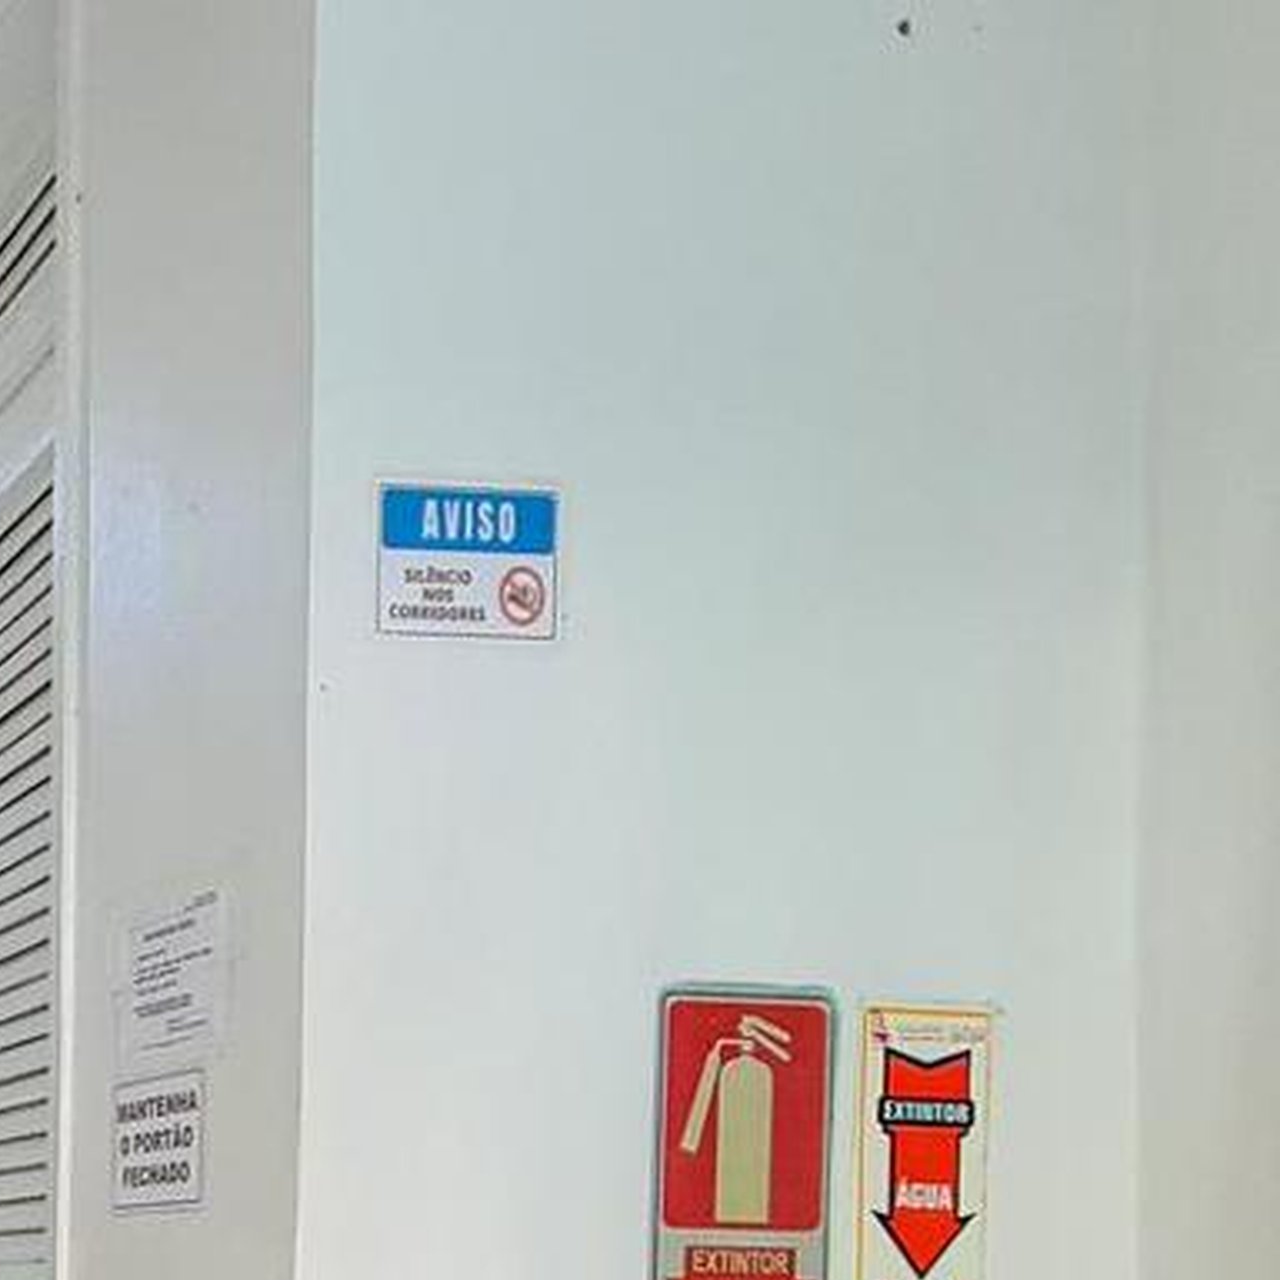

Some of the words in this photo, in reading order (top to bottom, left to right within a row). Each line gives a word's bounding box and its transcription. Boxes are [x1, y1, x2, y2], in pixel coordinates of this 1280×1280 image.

[421, 499, 516, 543] AVISO
[423, 589, 454, 602] NOS
[389, 603, 485, 621] CORRIDORES
[117, 1090, 198, 1123] MANTENHA
[883, 1101, 969, 1123] EXTINTOR
[121, 1136, 131, 1157] O
[134, 1122, 194, 1153] PORTÃO
[122, 1161, 191, 1188] FECHADO
[895, 1178, 952, 1209] ÁGUA
[692, 1249, 789, 1276] EXTINTOR
